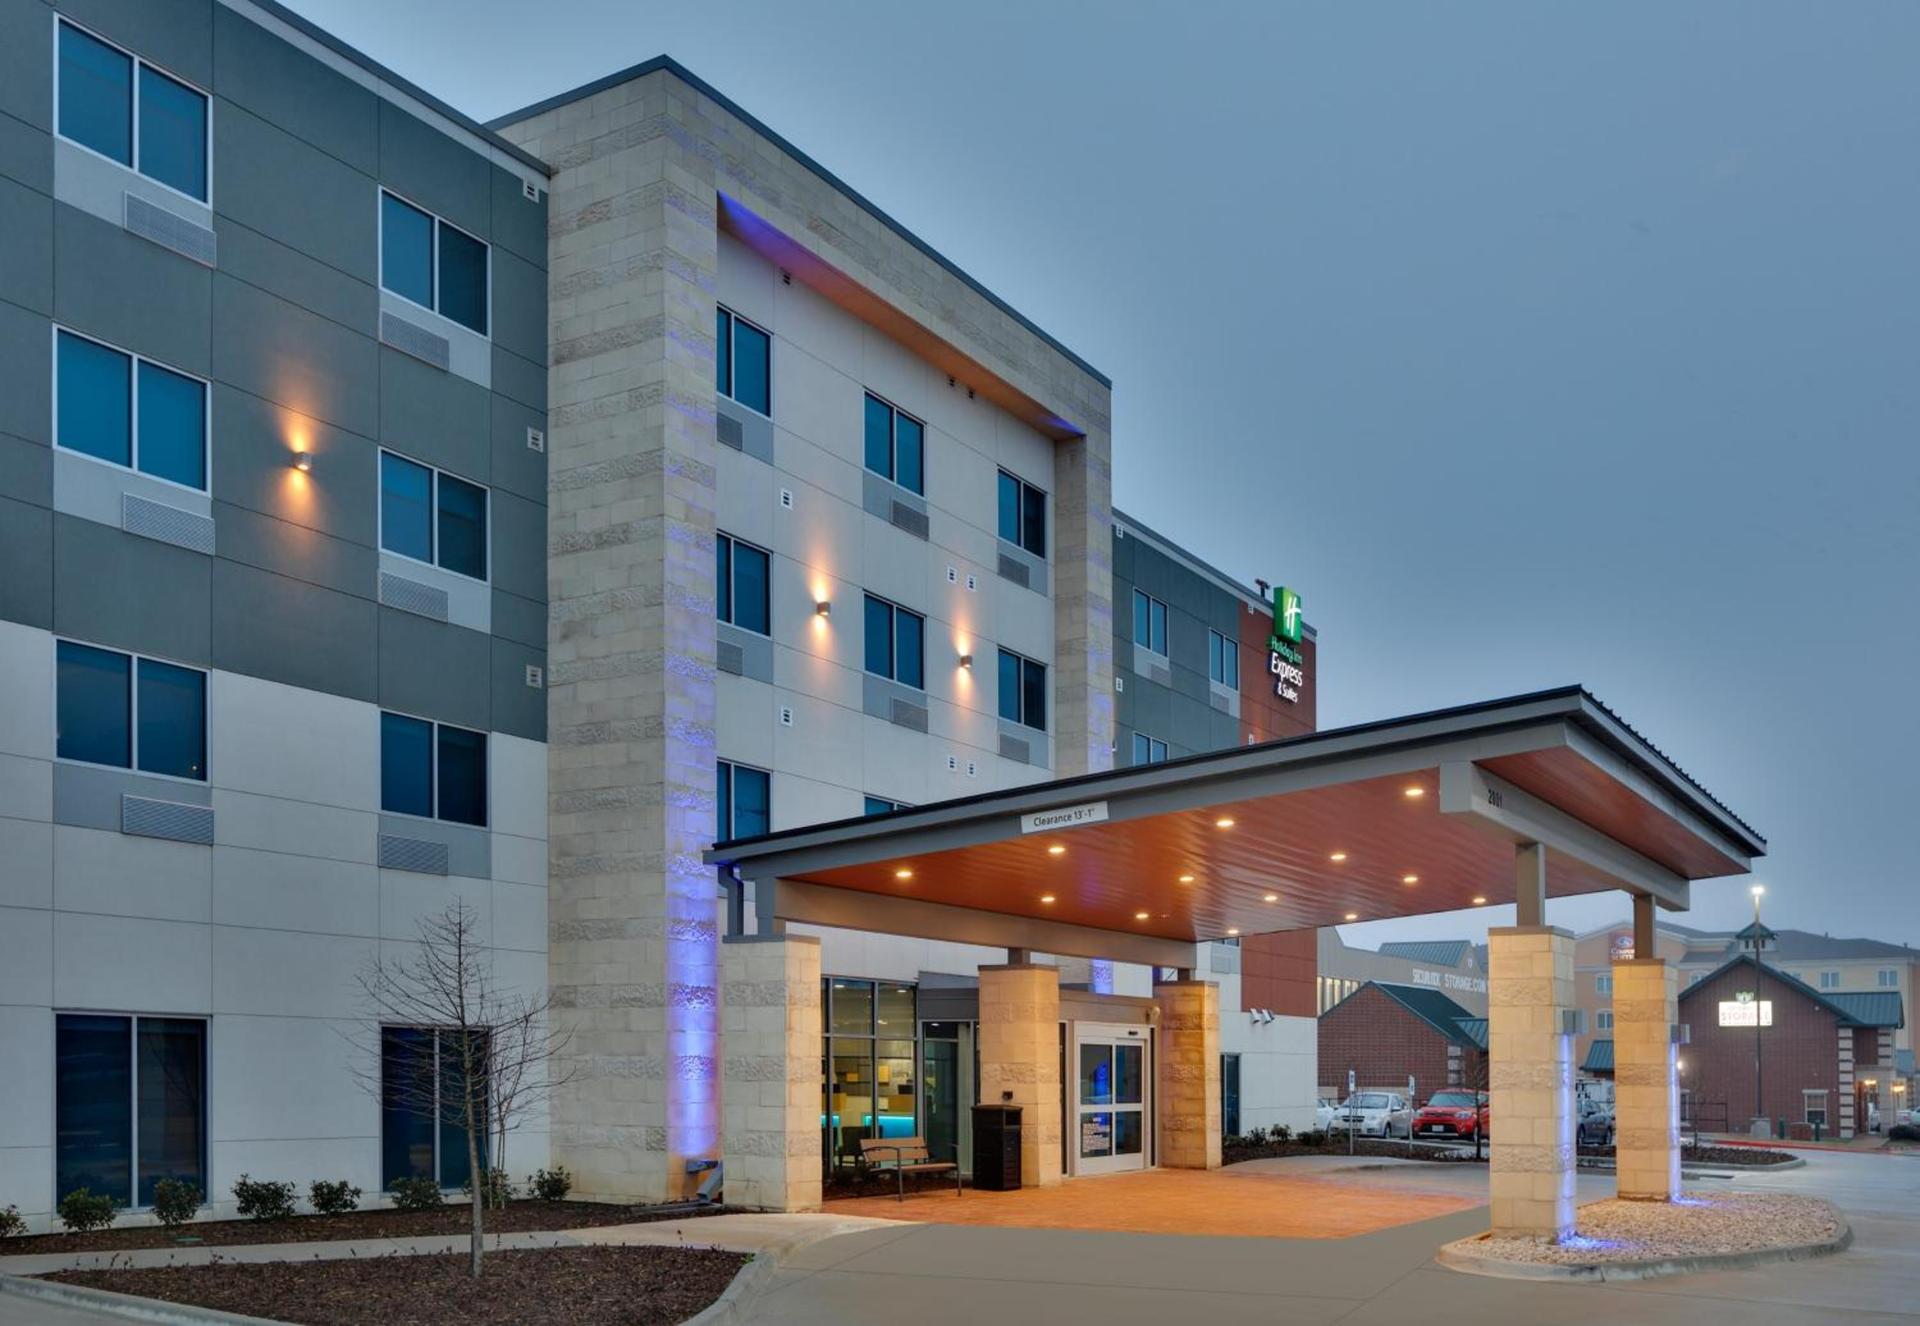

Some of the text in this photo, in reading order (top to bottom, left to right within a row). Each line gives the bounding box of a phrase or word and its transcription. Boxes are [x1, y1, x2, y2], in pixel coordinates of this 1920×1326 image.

[1271, 651, 1303, 687] Express
[1282, 684, 1299, 704] Suites
[1033, 813, 1072, 827] Clearance
[1721, 1011, 1768, 1022] STORAE
